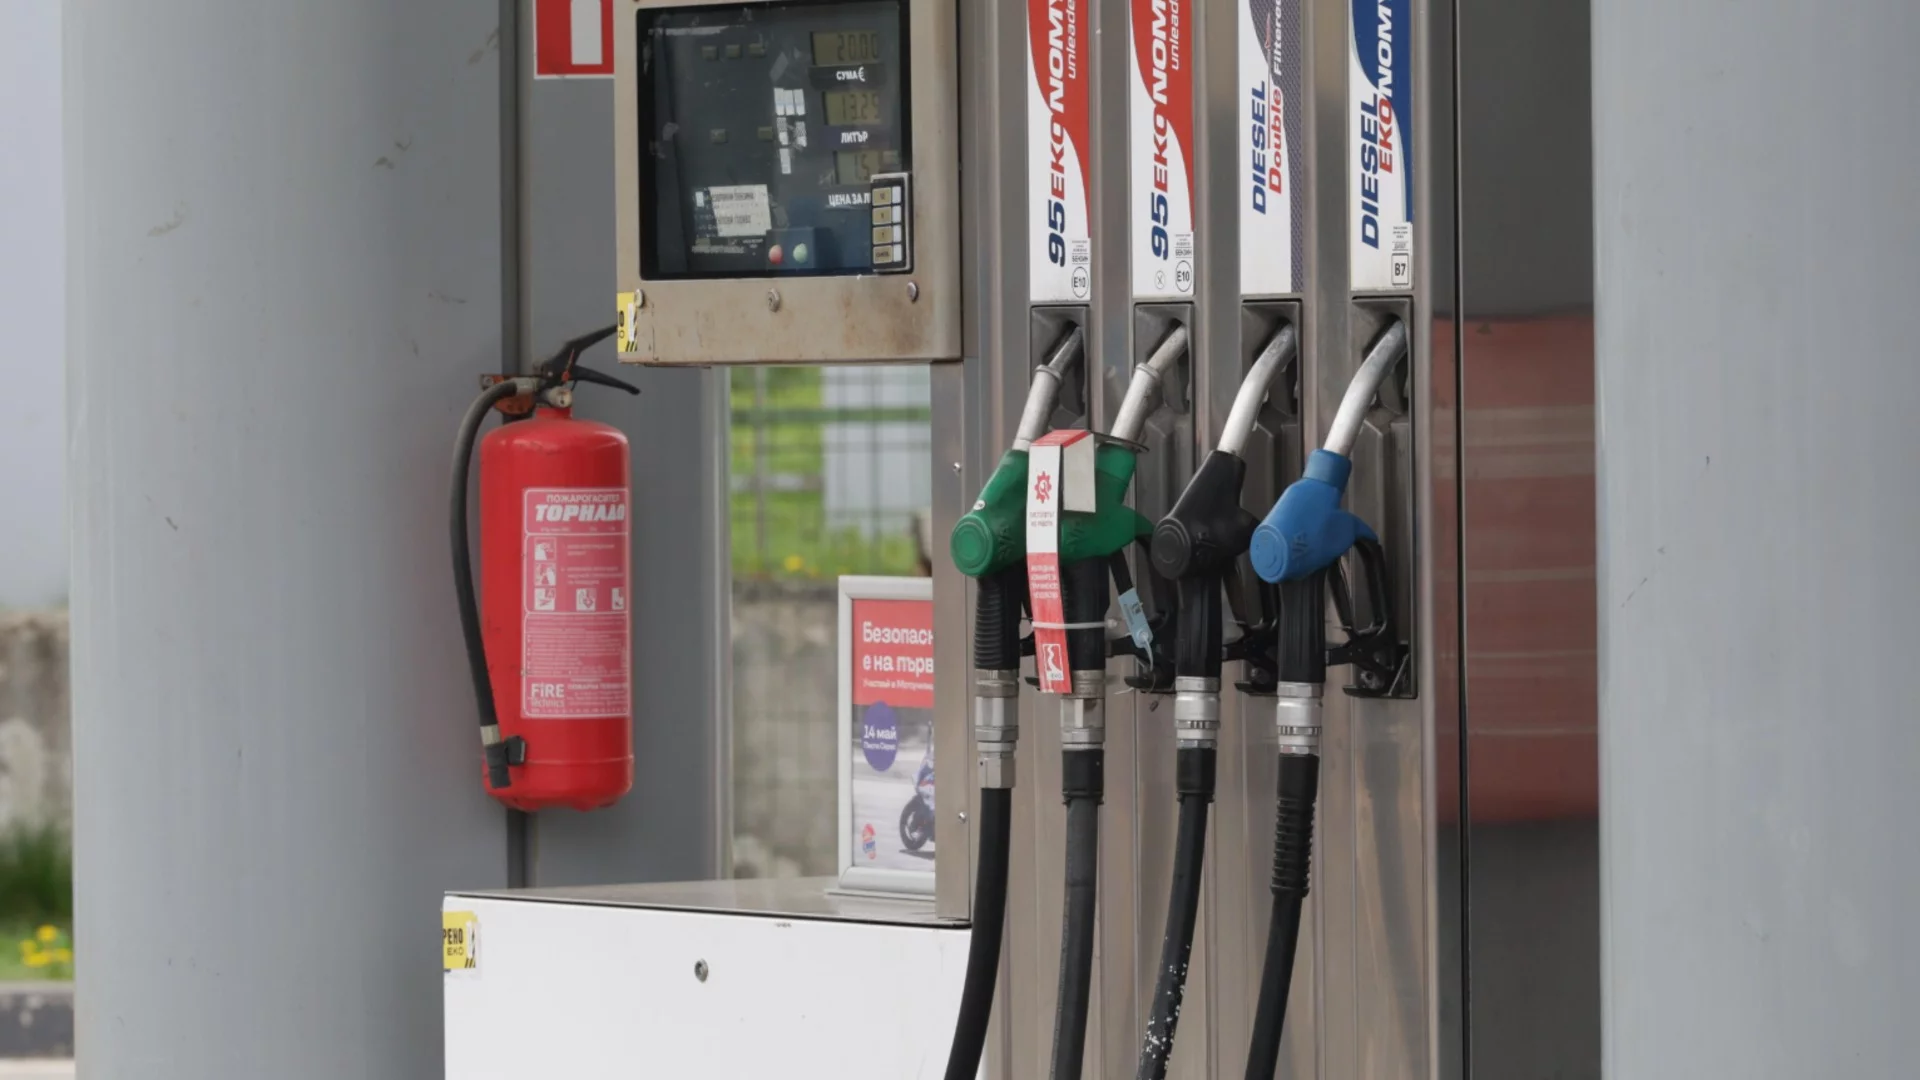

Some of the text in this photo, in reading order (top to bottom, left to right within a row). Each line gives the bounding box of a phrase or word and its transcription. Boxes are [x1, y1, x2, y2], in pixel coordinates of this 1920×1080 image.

[1377, 0, 1393, 174] EKONOM
[841, 131, 868, 143] ЛИТЪР
[1268, 87, 1282, 195] Double
[1251, 80, 1266, 215] DIESEL
[1360, 93, 1379, 250] DIESEL
[828, 194, 850, 206] ЦЕНА
[1177, 271, 1189, 282] E10
[1394, 263, 1406, 276] B7
[1073, 277, 1086, 288] E10
[535, 504, 625, 522] ТОРНАДО
[863, 655, 934, 678] е на първ
[864, 724, 897, 740] 14 май
